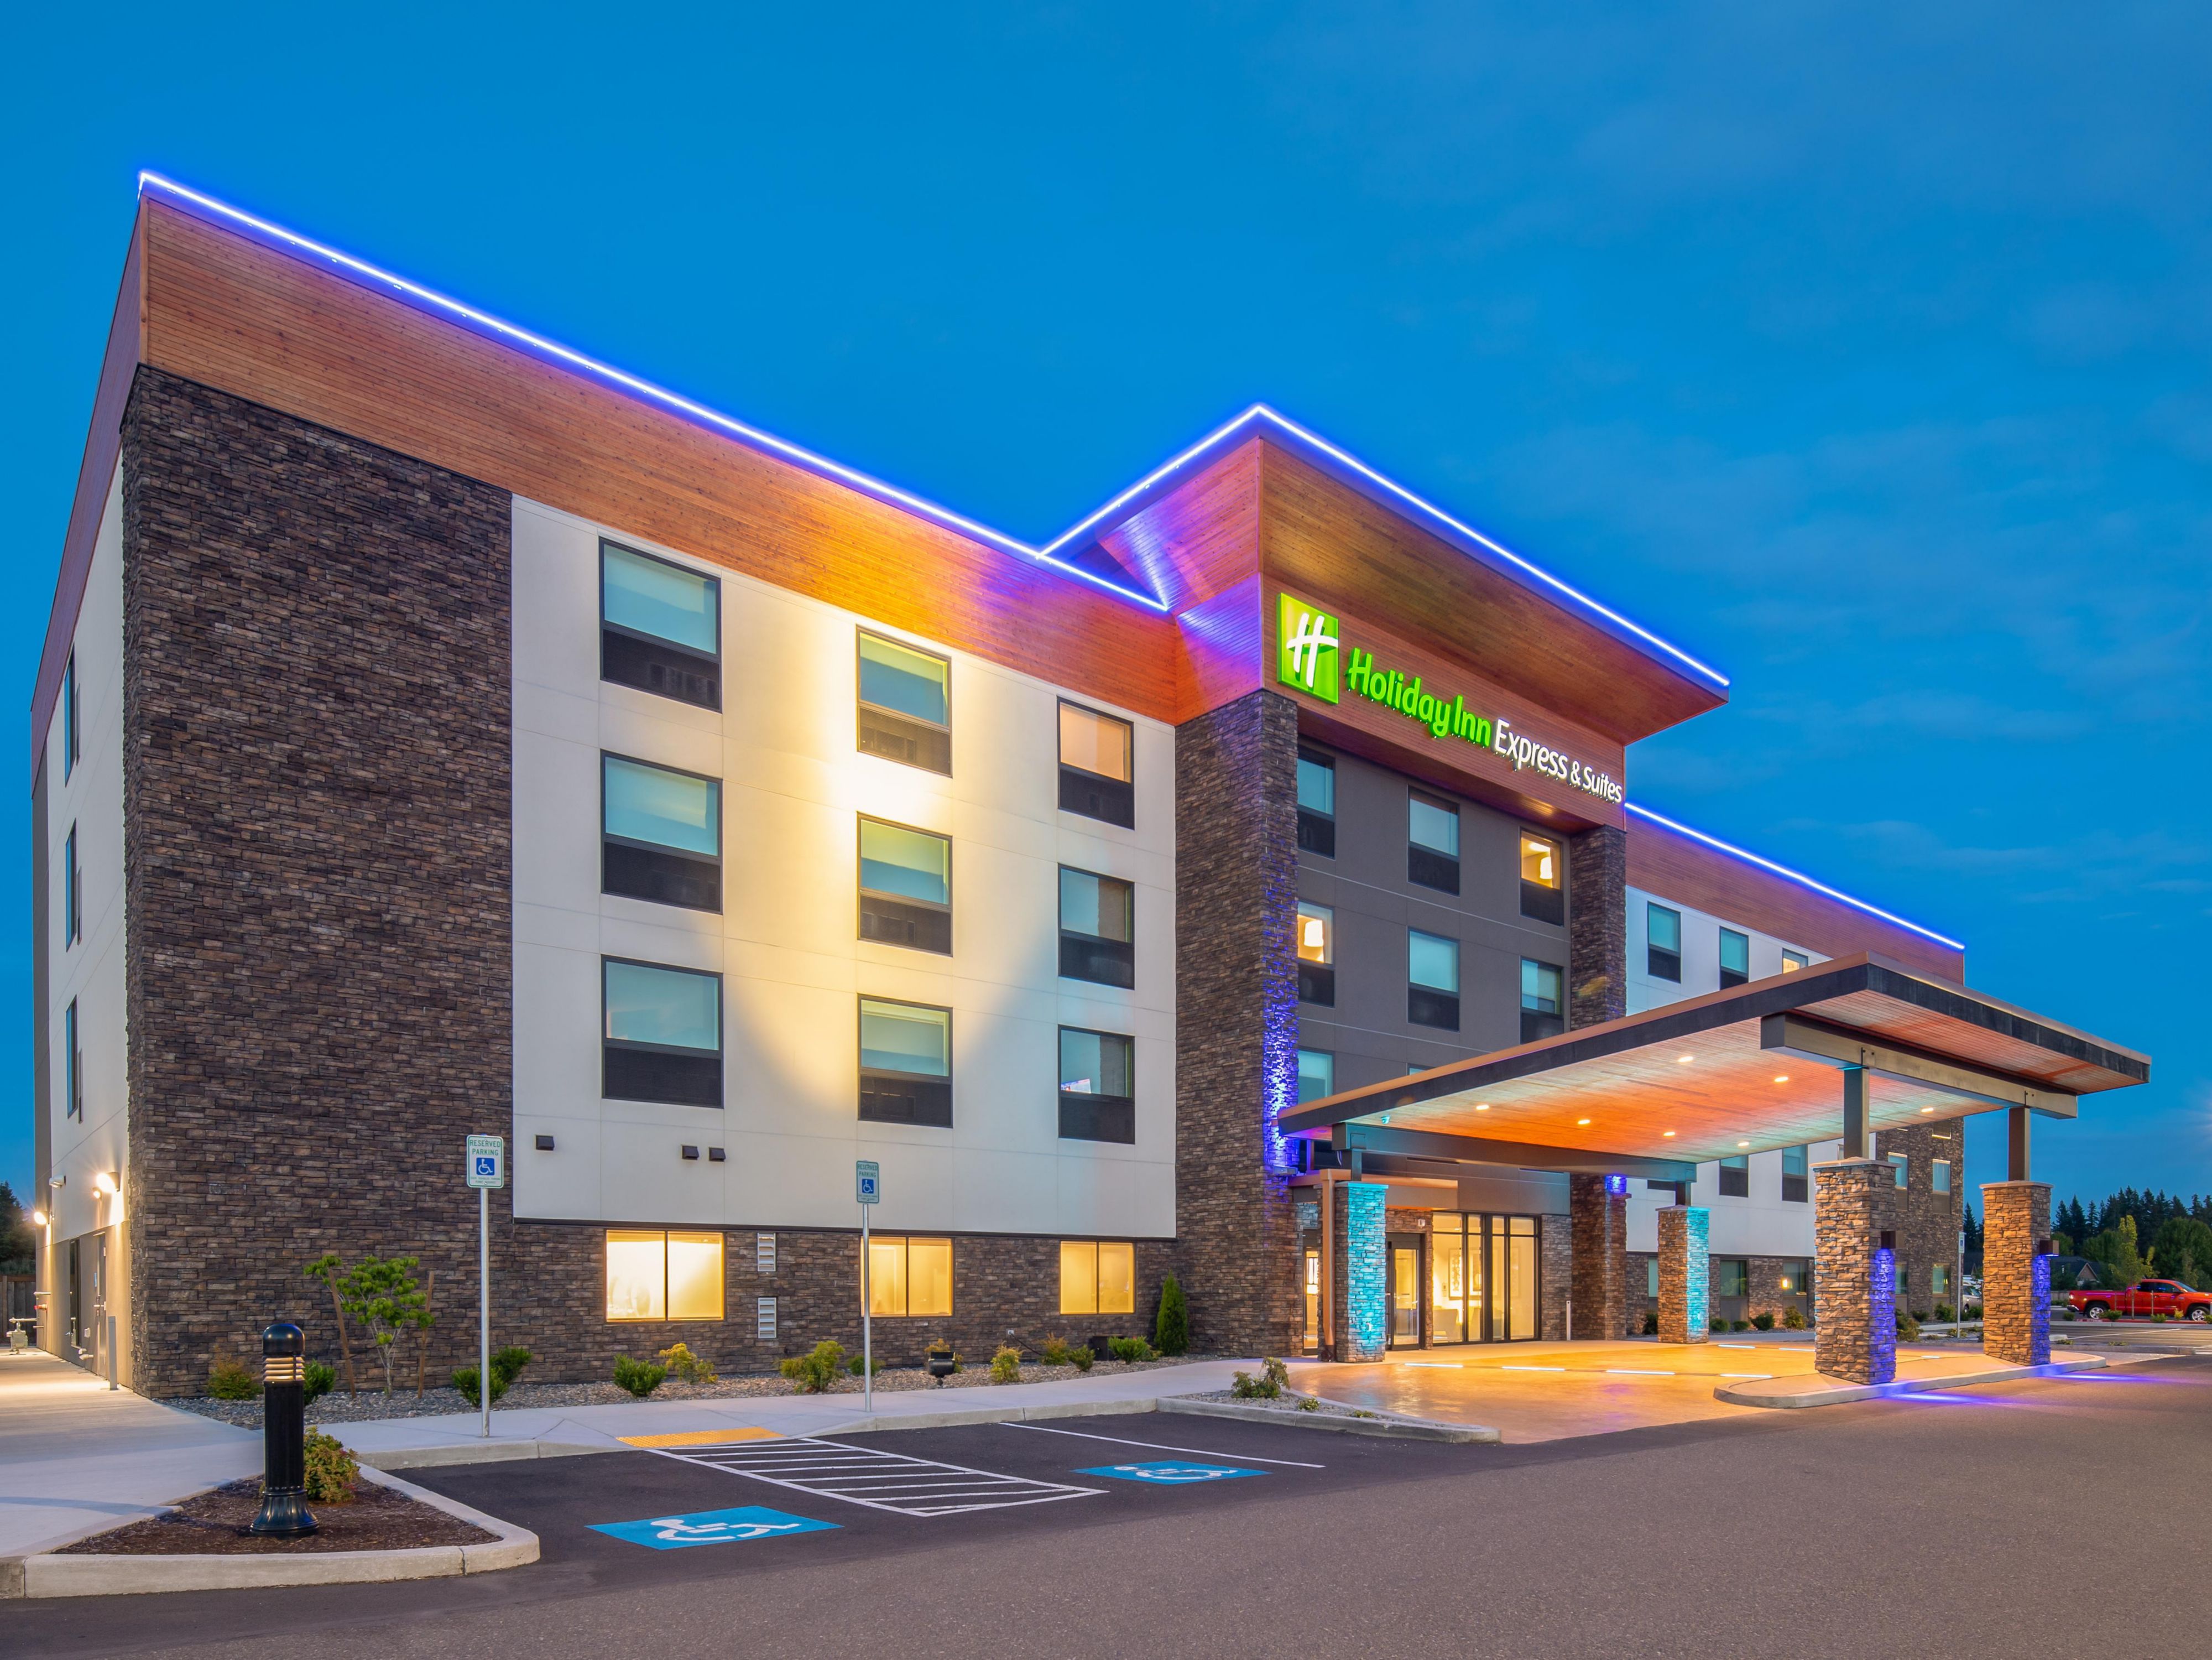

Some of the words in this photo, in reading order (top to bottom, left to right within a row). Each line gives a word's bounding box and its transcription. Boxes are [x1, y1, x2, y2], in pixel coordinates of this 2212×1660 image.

[1348, 647, 1451, 737] Holiday
[1453, 694, 1491, 747] Inn
[1494, 719, 1569, 779] Express
[1571, 761, 1581, 787] &
[1583, 766, 1623, 803] Suites
[469, 1139, 500, 1148] RESERVED
